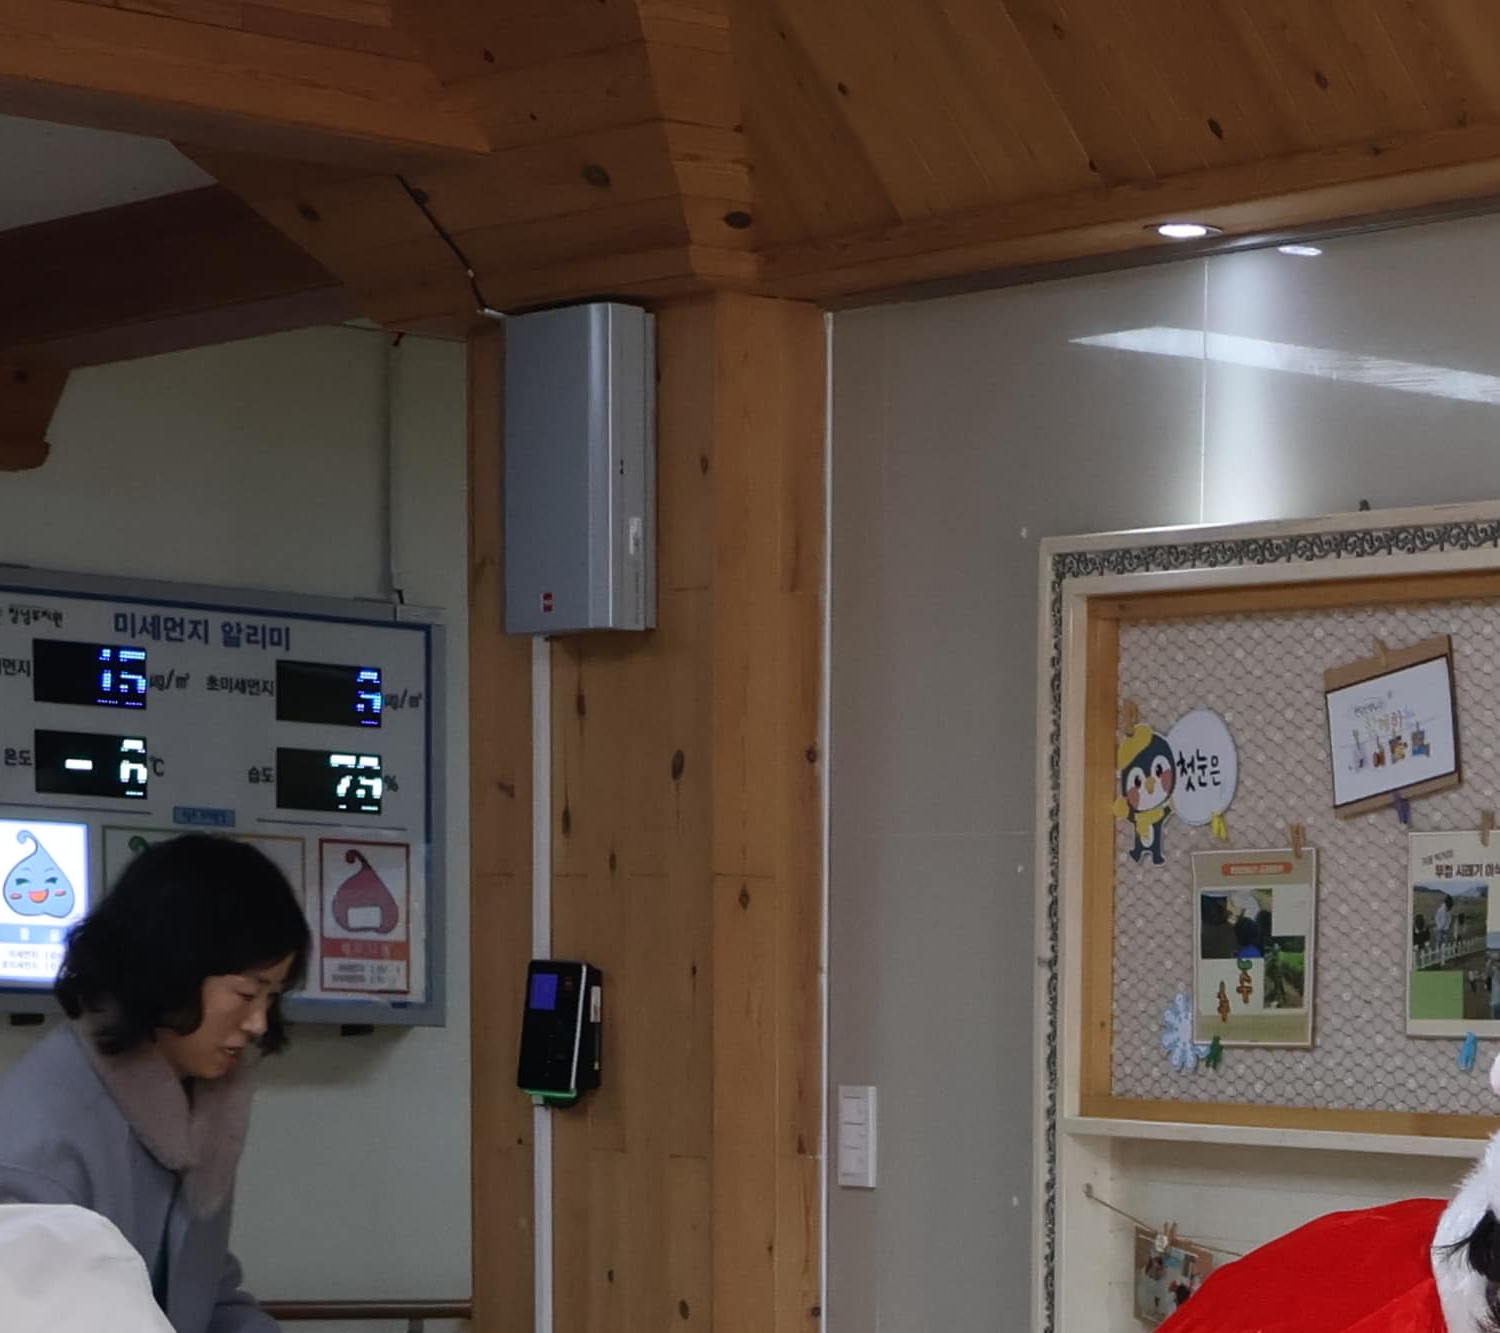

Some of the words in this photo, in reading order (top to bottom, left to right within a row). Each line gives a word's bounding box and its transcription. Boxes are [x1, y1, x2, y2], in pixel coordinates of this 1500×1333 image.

[113, 612, 209, 645] 미세먼지
[221, 622, 290, 651] 알리미
[206, 675, 275, 697] 초미세먼지
[4, 748, 32, 767] 온도
[248, 767, 274, 785] 습도
[1176, 749, 1222, 793] 첫눈은
